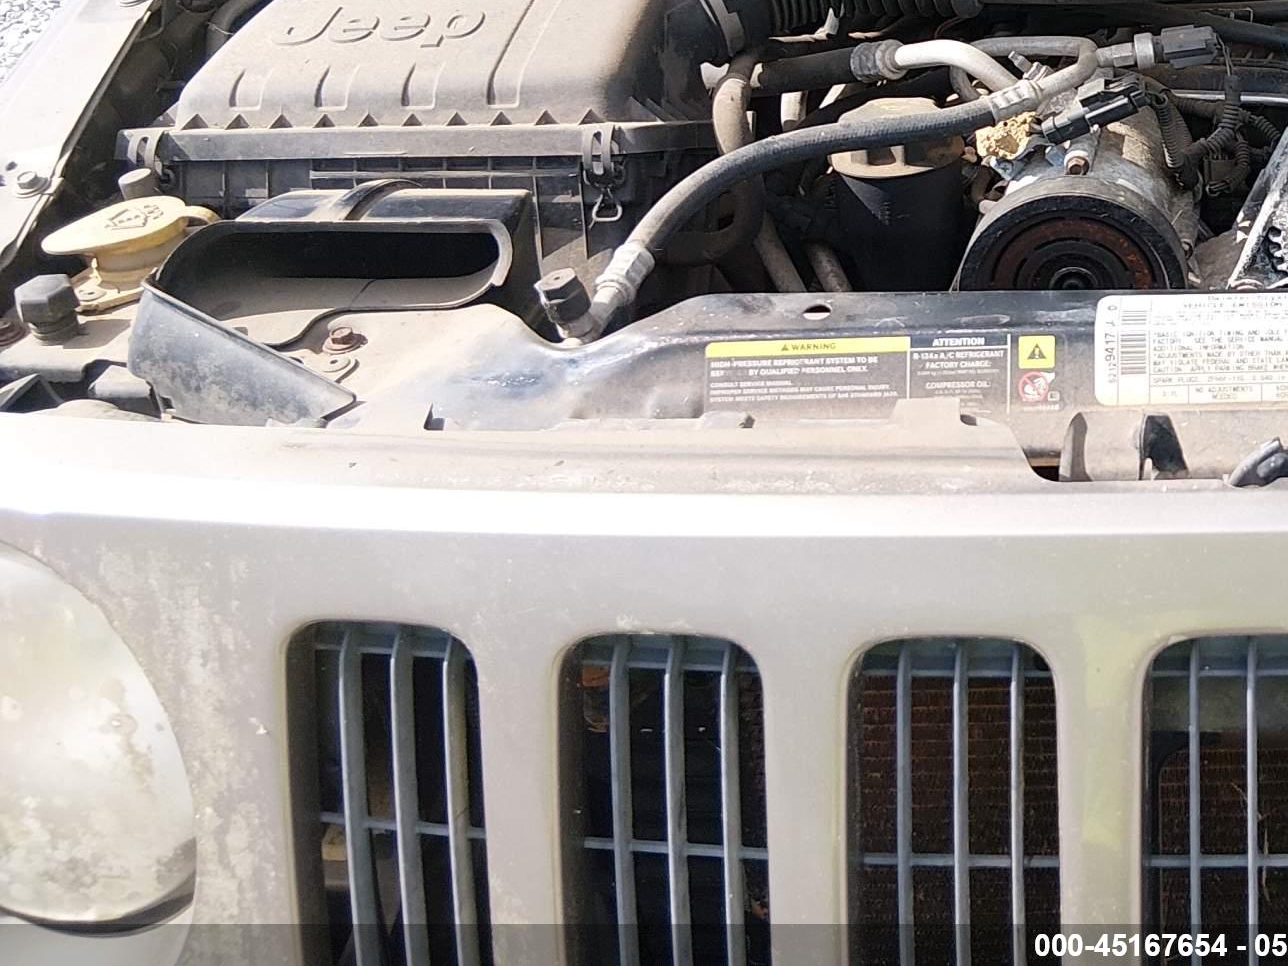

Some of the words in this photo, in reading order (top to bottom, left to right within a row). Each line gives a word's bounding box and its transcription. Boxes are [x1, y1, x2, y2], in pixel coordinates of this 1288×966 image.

[272, 5, 486, 48] Jeep
[791, 342, 837, 351] WARNING
[932, 337, 986, 347] ATTENTION
[955, 350, 1005, 359] REFRIGERANT
[826, 357, 856, 366] SYSTEM
[857, 356, 867, 364] TO
[867, 356, 878, 364] BE
[925, 361, 959, 370] FACTORY
[748, 368, 758, 377] BY
[925, 381, 976, 390] COMPRESSOR
